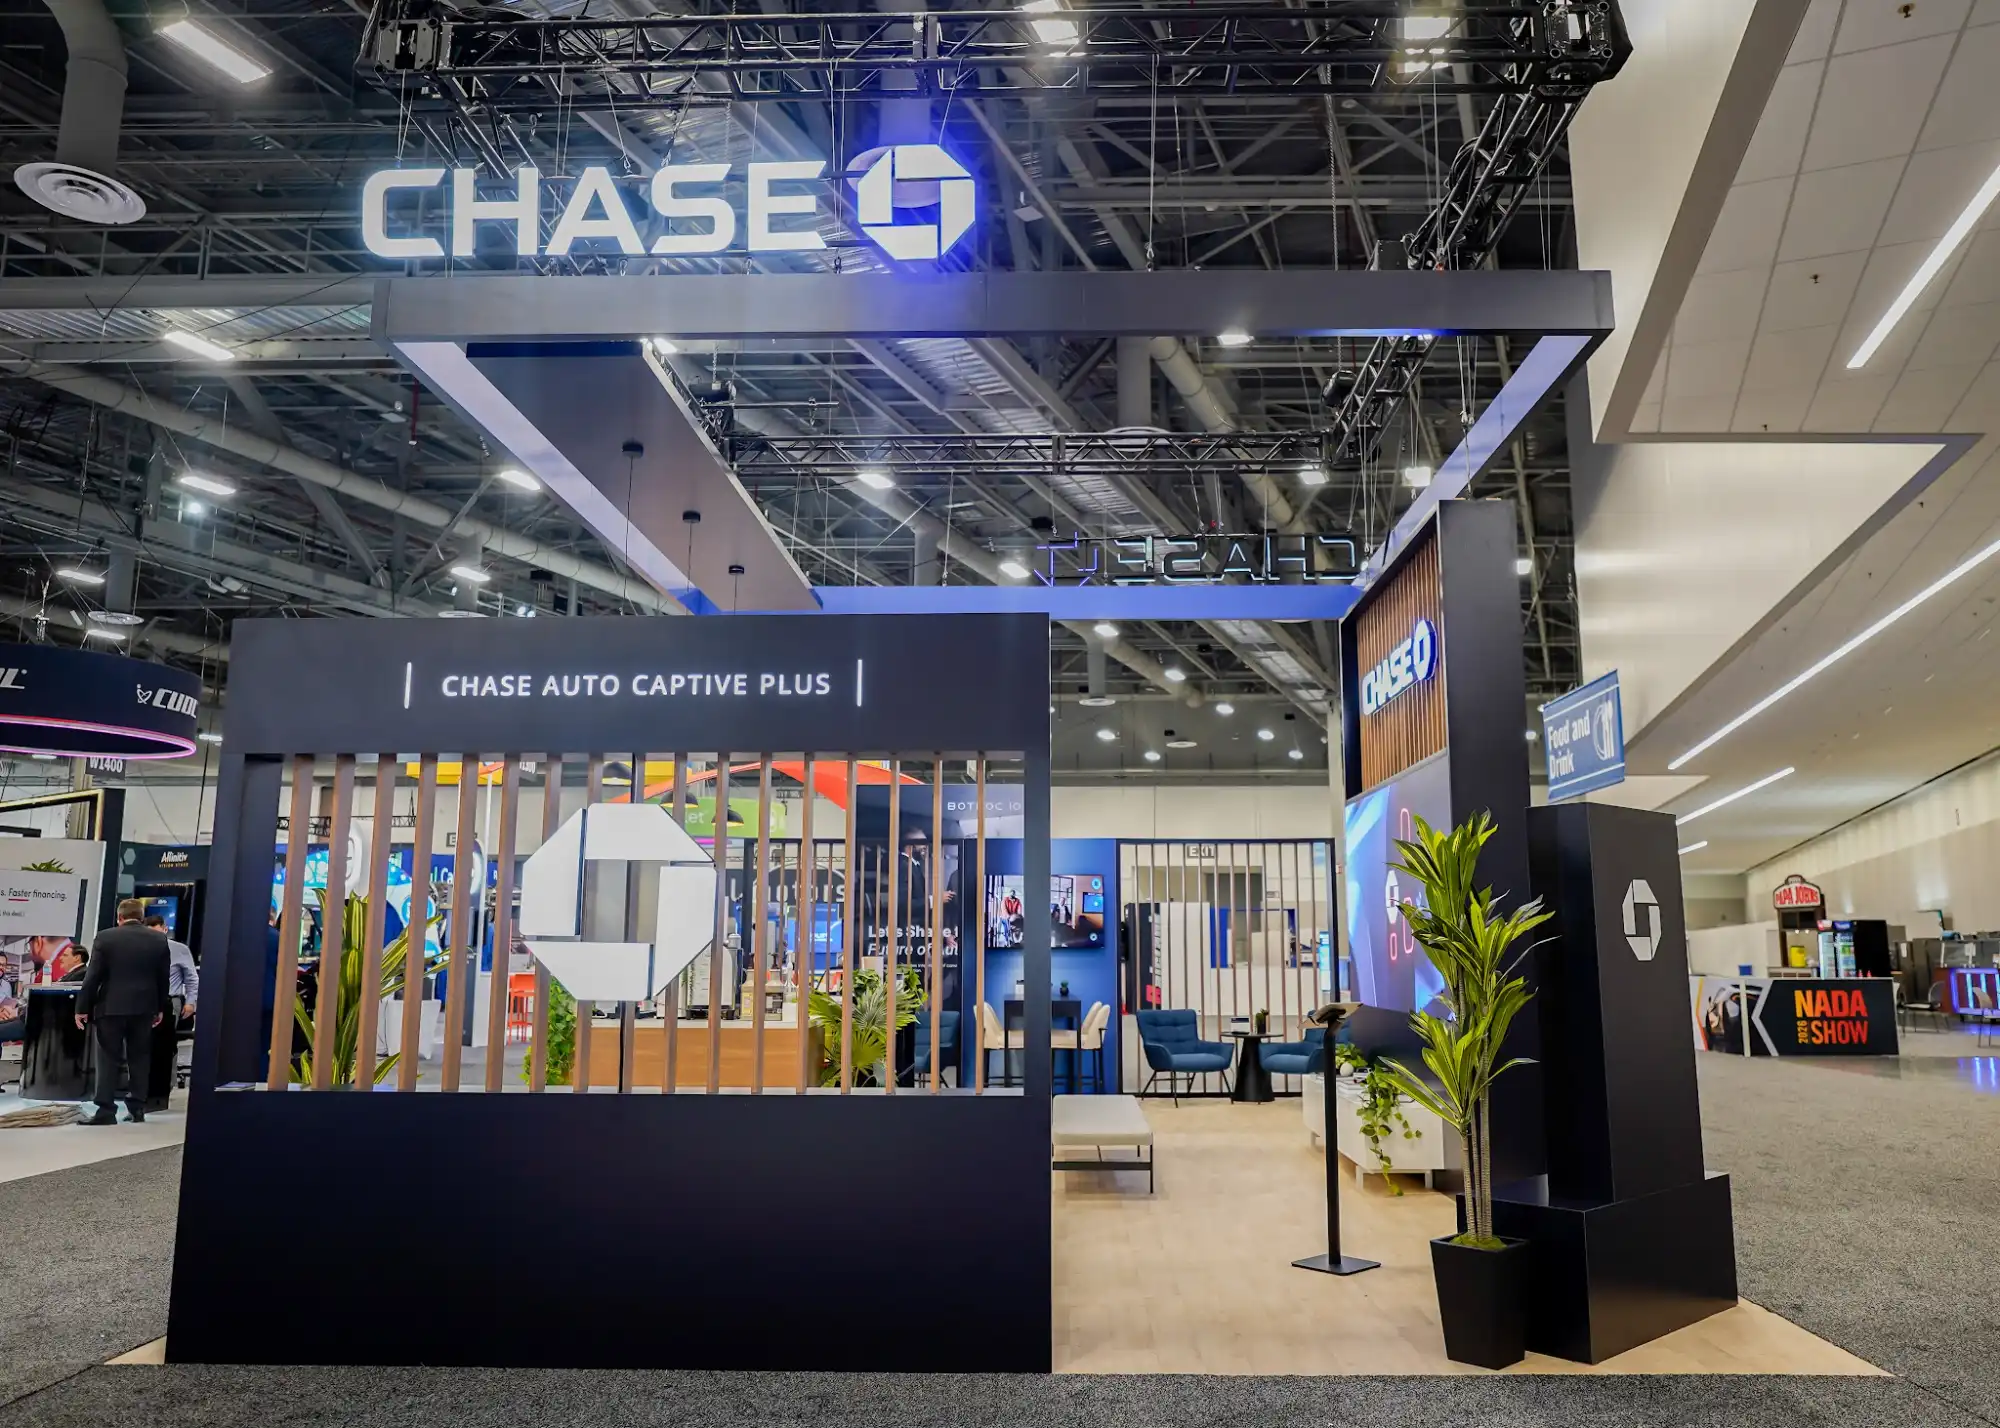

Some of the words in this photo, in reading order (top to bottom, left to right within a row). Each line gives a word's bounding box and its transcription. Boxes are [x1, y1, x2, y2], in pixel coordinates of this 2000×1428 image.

[361, 160, 829, 258] CHASE
[441, 675, 532, 697] CHASE
[541, 674, 620, 697] AUTO
[631, 674, 748, 696] CAPTIVE
[759, 673, 831, 696] PLUS
[1361, 637, 1414, 716] CHASE
[152, 688, 199, 719] CUDL
[1547, 719, 1571, 752] Food
[1571, 709, 1591, 742] and
[1549, 748, 1575, 780] Drink
[947, 802, 1004, 812] BOTOC
[1188, 845, 1216, 858] EXIT
[8, 888, 32, 898] Faster
[32, 889, 68, 902] financing.
[1794, 989, 1868, 1018] NADA
[1796, 1020, 1809, 1044] 2026
[1810, 1020, 1869, 1045] SHOW
